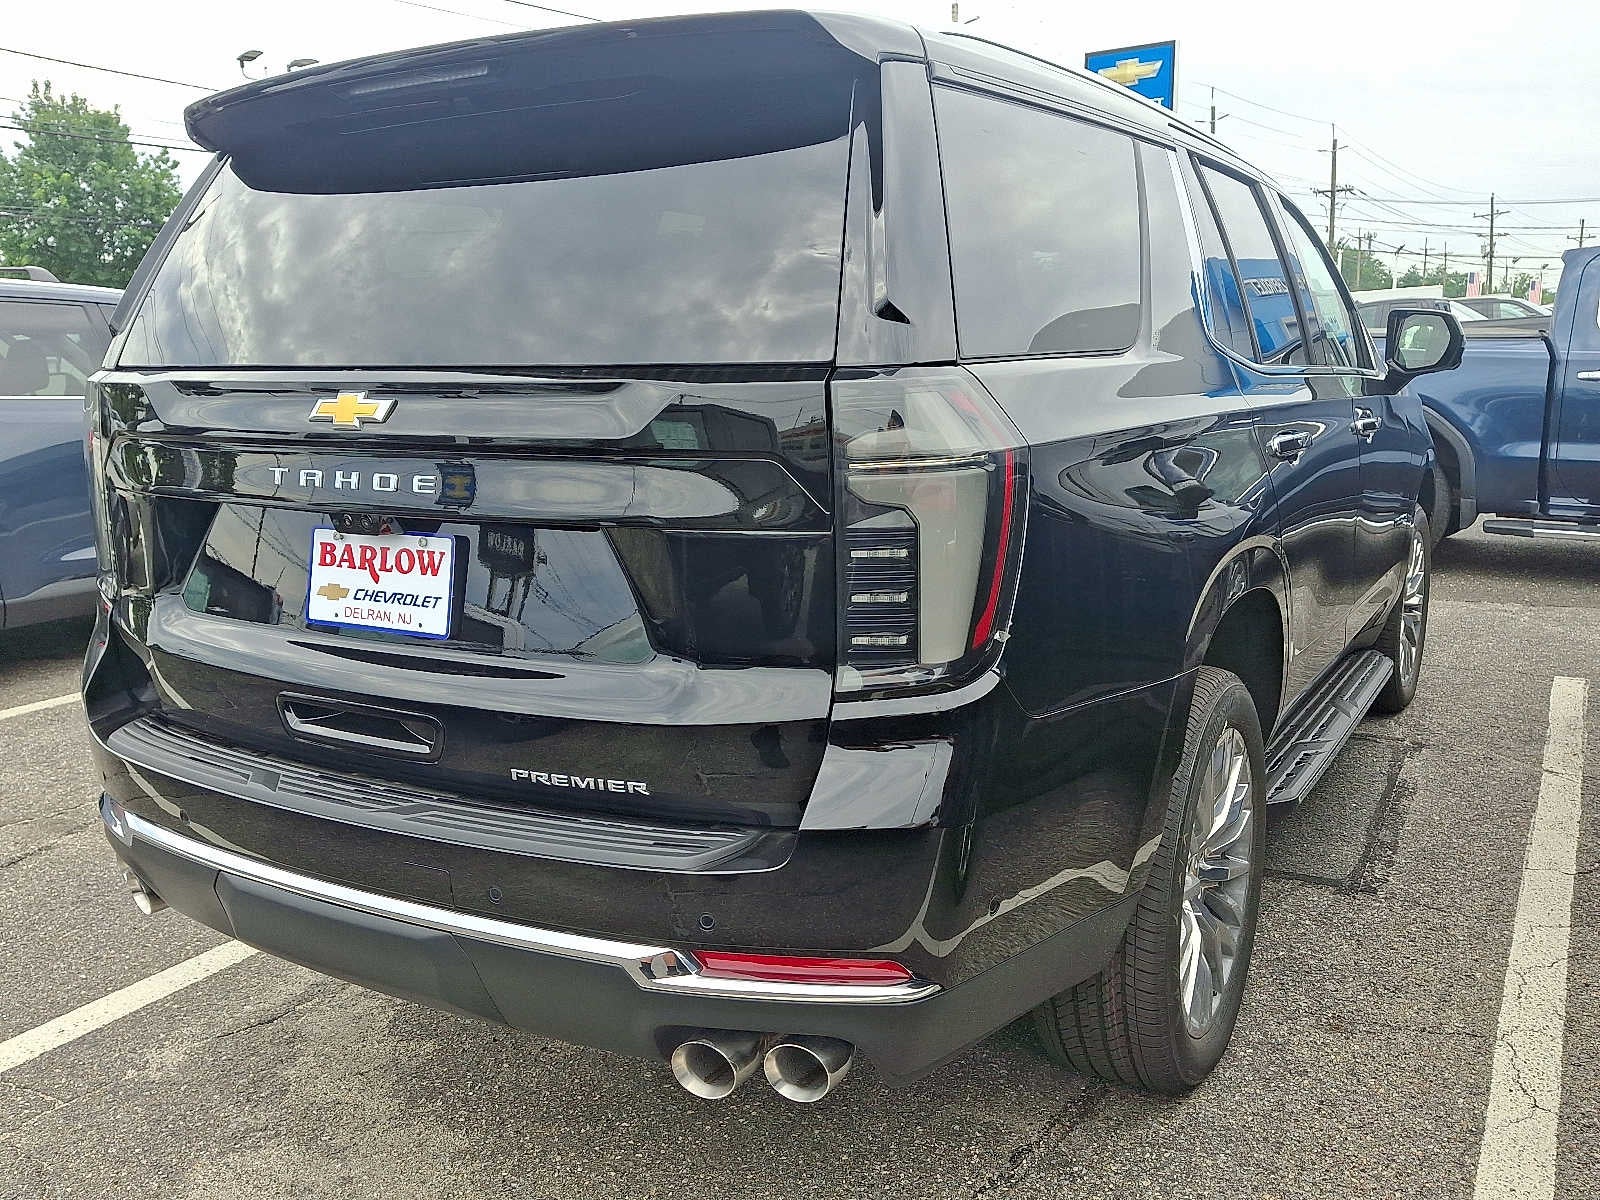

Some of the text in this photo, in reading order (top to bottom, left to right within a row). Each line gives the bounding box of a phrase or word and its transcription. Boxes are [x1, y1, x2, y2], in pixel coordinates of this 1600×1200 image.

[269, 467, 437, 494] TAHOE
[318, 541, 445, 584] BARLOW
[353, 588, 442, 609] CHEVROLET
[344, 606, 412, 625] DELRAN, NJ
[510, 768, 650, 796] PREMIER
